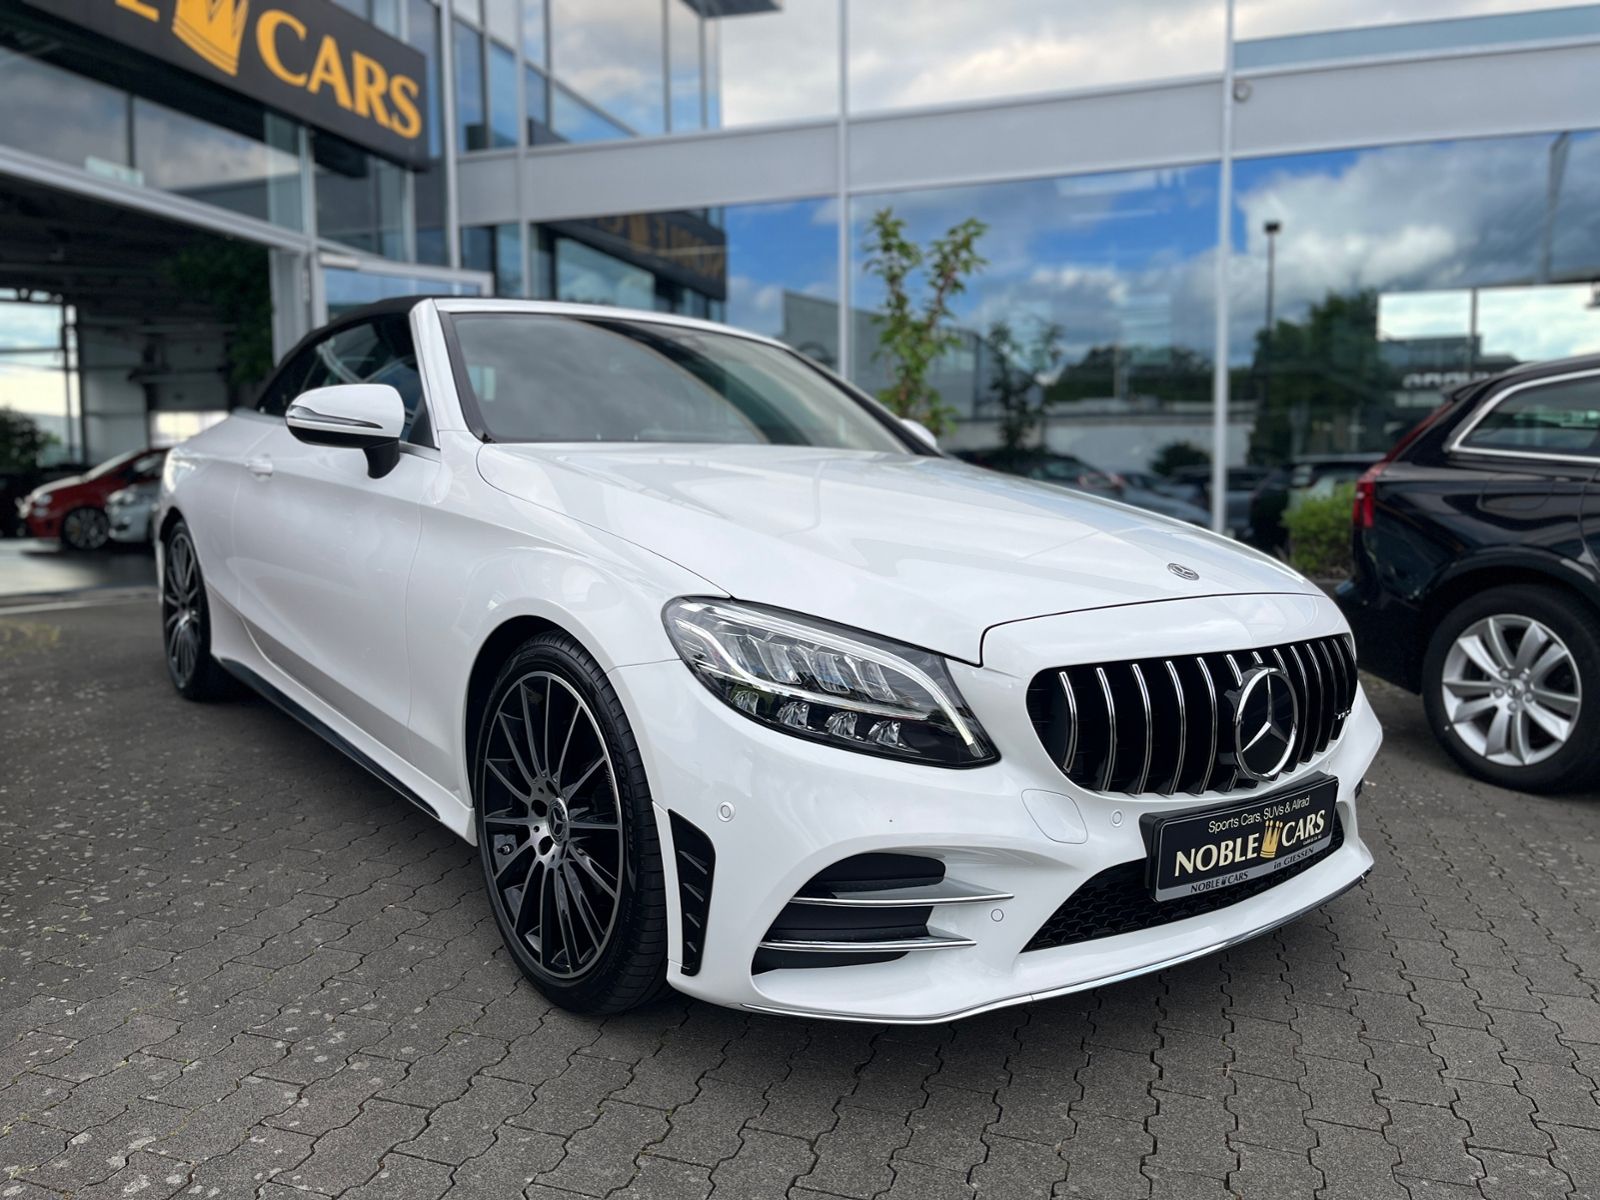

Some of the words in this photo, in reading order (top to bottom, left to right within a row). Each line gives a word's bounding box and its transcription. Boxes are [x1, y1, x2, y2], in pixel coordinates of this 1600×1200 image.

[255, 9, 422, 139] CARS
[1208, 818, 1239, 834] Sports
[1263, 804, 1284, 820] SUVs
[1284, 801, 1291, 814] &
[1291, 795, 1310, 811] Allrad
[1174, 832, 1260, 877] NOBLE
[1281, 809, 1325, 847] CARS
[1273, 861, 1281, 870] in
[1283, 846, 1314, 865] GIESSEN
[1190, 879, 1220, 893] NOBLE
[1227, 871, 1249, 884] CARS
